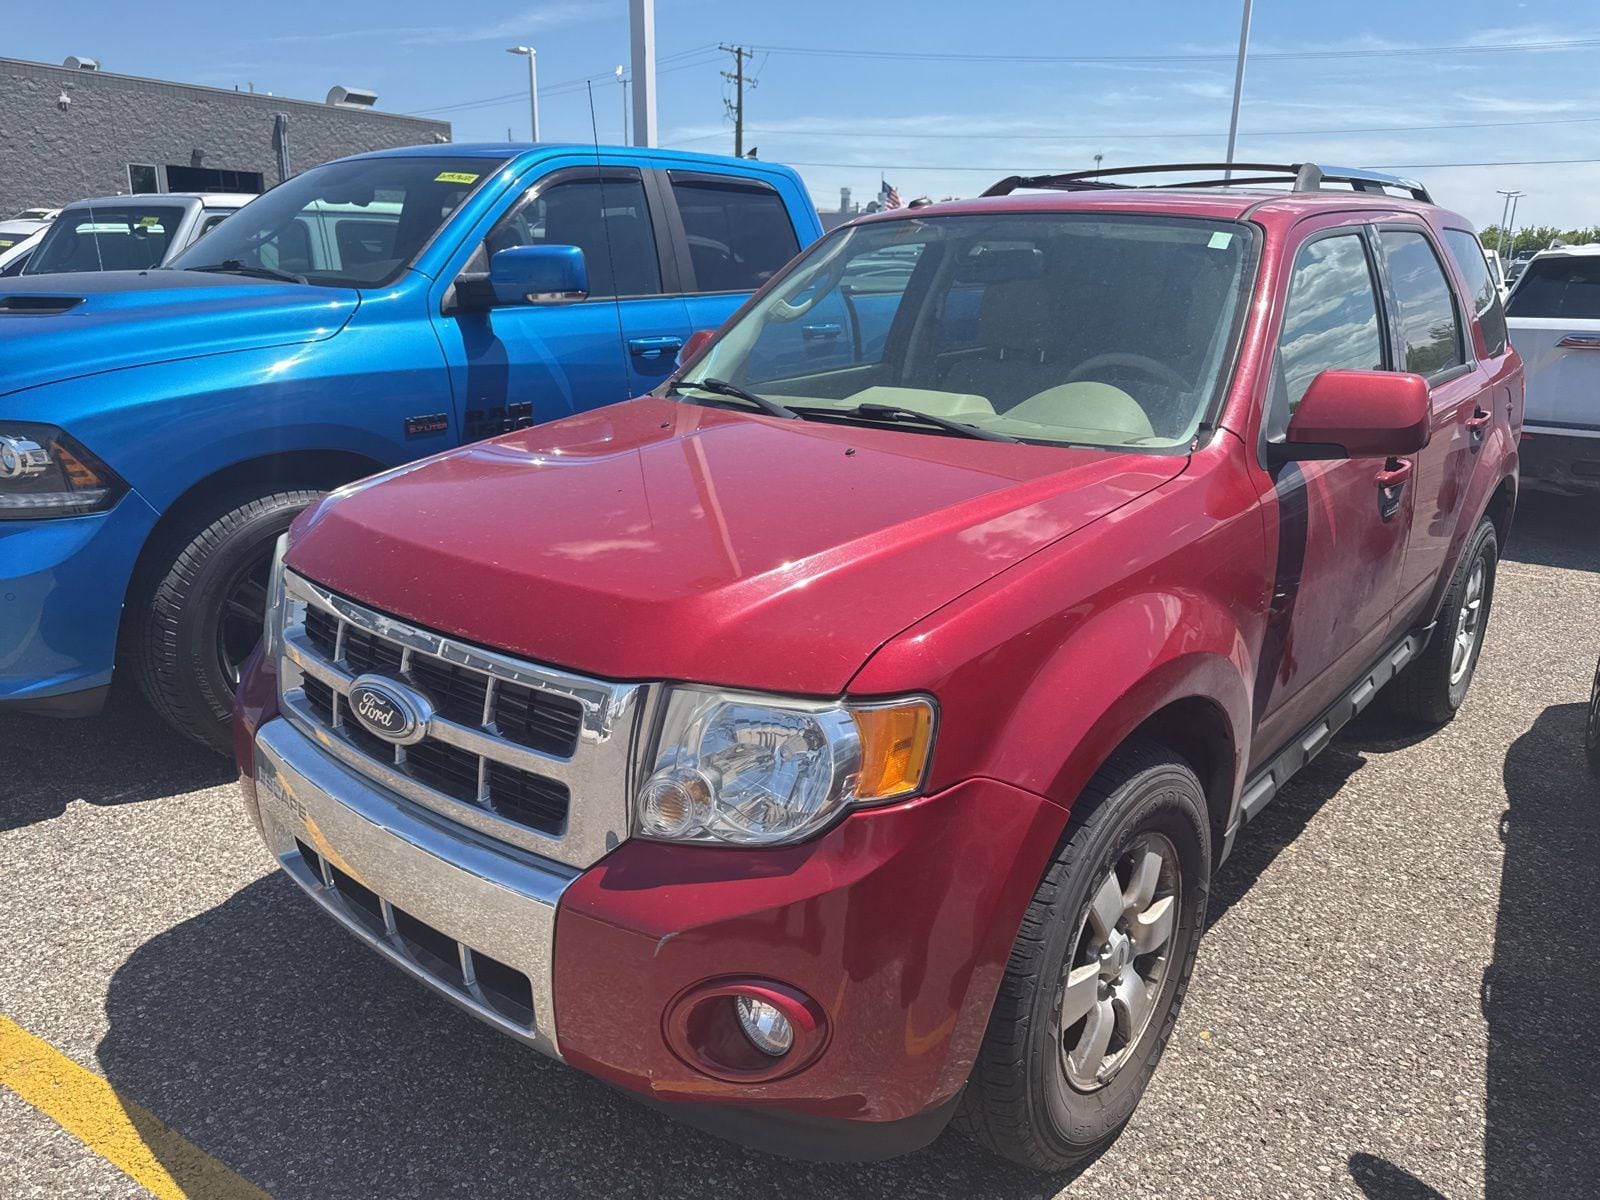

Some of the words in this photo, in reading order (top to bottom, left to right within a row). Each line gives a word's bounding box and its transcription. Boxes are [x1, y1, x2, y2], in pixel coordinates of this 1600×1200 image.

[424, 421, 449, 432] LITER
[358, 691, 395, 727] Ford
[257, 765, 308, 822] ESCAPE
